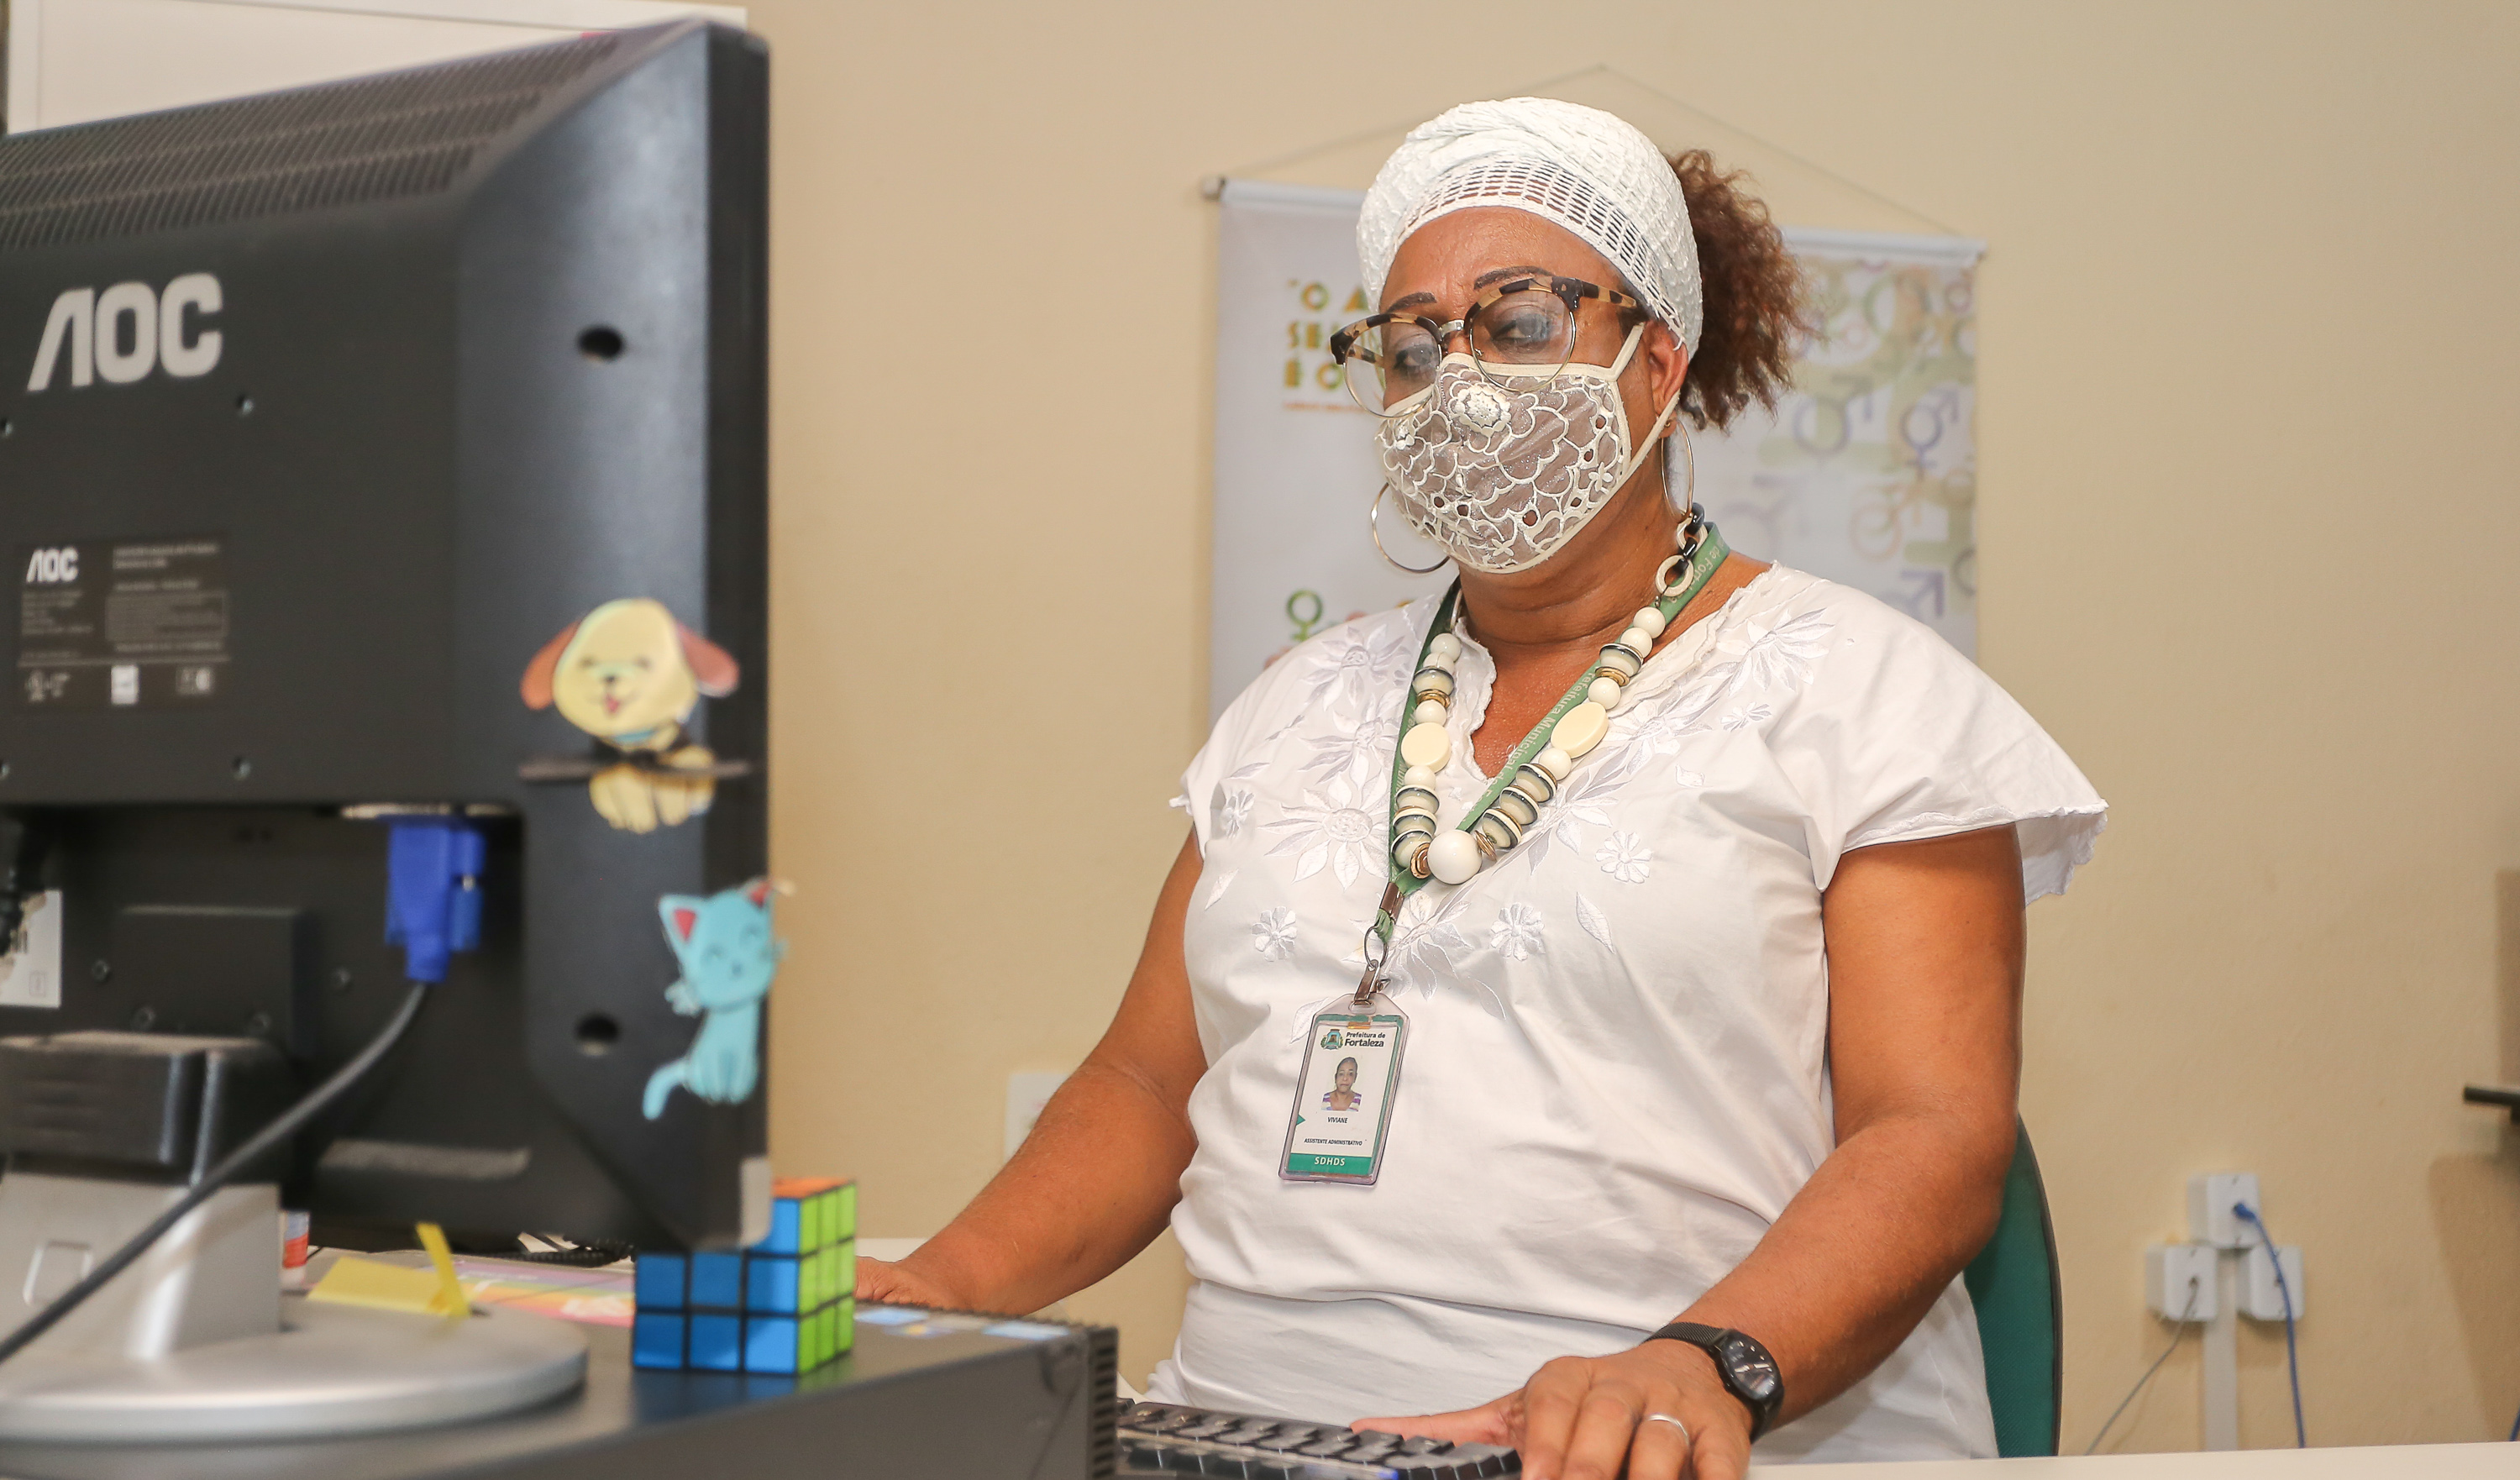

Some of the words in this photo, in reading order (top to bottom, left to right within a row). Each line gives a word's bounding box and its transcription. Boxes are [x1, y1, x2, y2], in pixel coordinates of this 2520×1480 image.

[27, 272, 223, 393] AOC
[25, 546, 80, 583] AOC
[1552, 666, 1599, 715] refeitura
[1507, 716, 1557, 770] Municipal
[1344, 1038, 1384, 1047] Fortaleza
[1314, 1156, 1346, 1166] SDHDS
